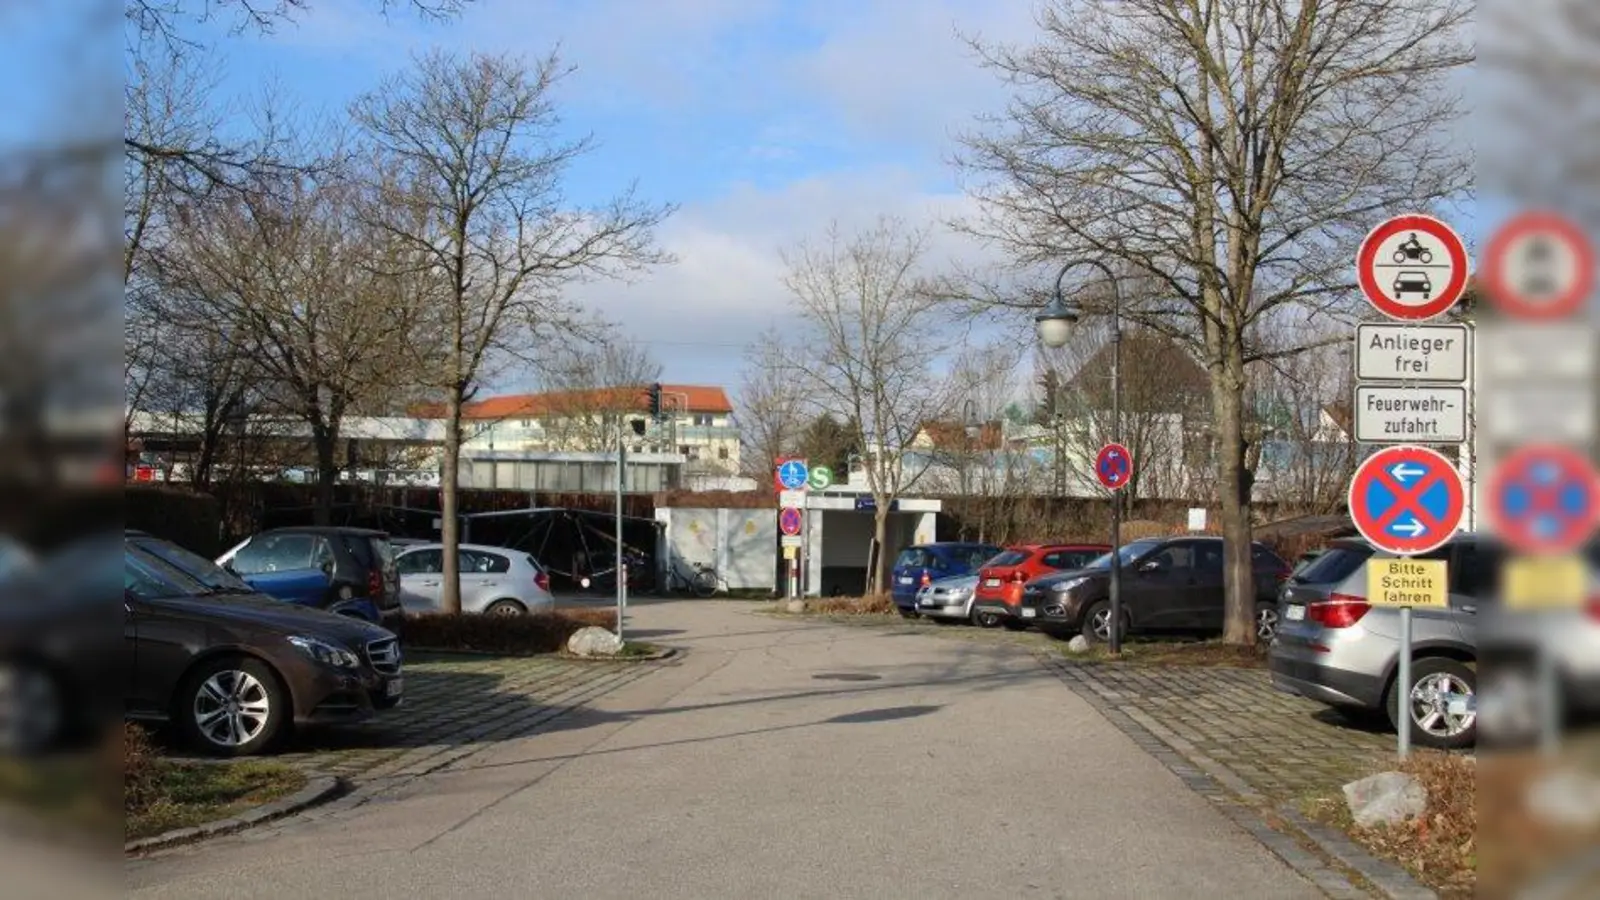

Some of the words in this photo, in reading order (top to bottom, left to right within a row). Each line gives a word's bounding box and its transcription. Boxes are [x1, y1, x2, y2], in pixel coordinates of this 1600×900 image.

[1369, 333, 1454, 355] Anlieger
[1395, 356, 1428, 372] frei
[1367, 394, 1455, 412] Feuerwehr-
[1384, 417, 1438, 433] zufahrt
[812, 466, 829, 488] S
[1389, 563, 1426, 575] Bitte
[1381, 575, 1433, 589] Schritt
[1384, 590, 1432, 603] fahren
